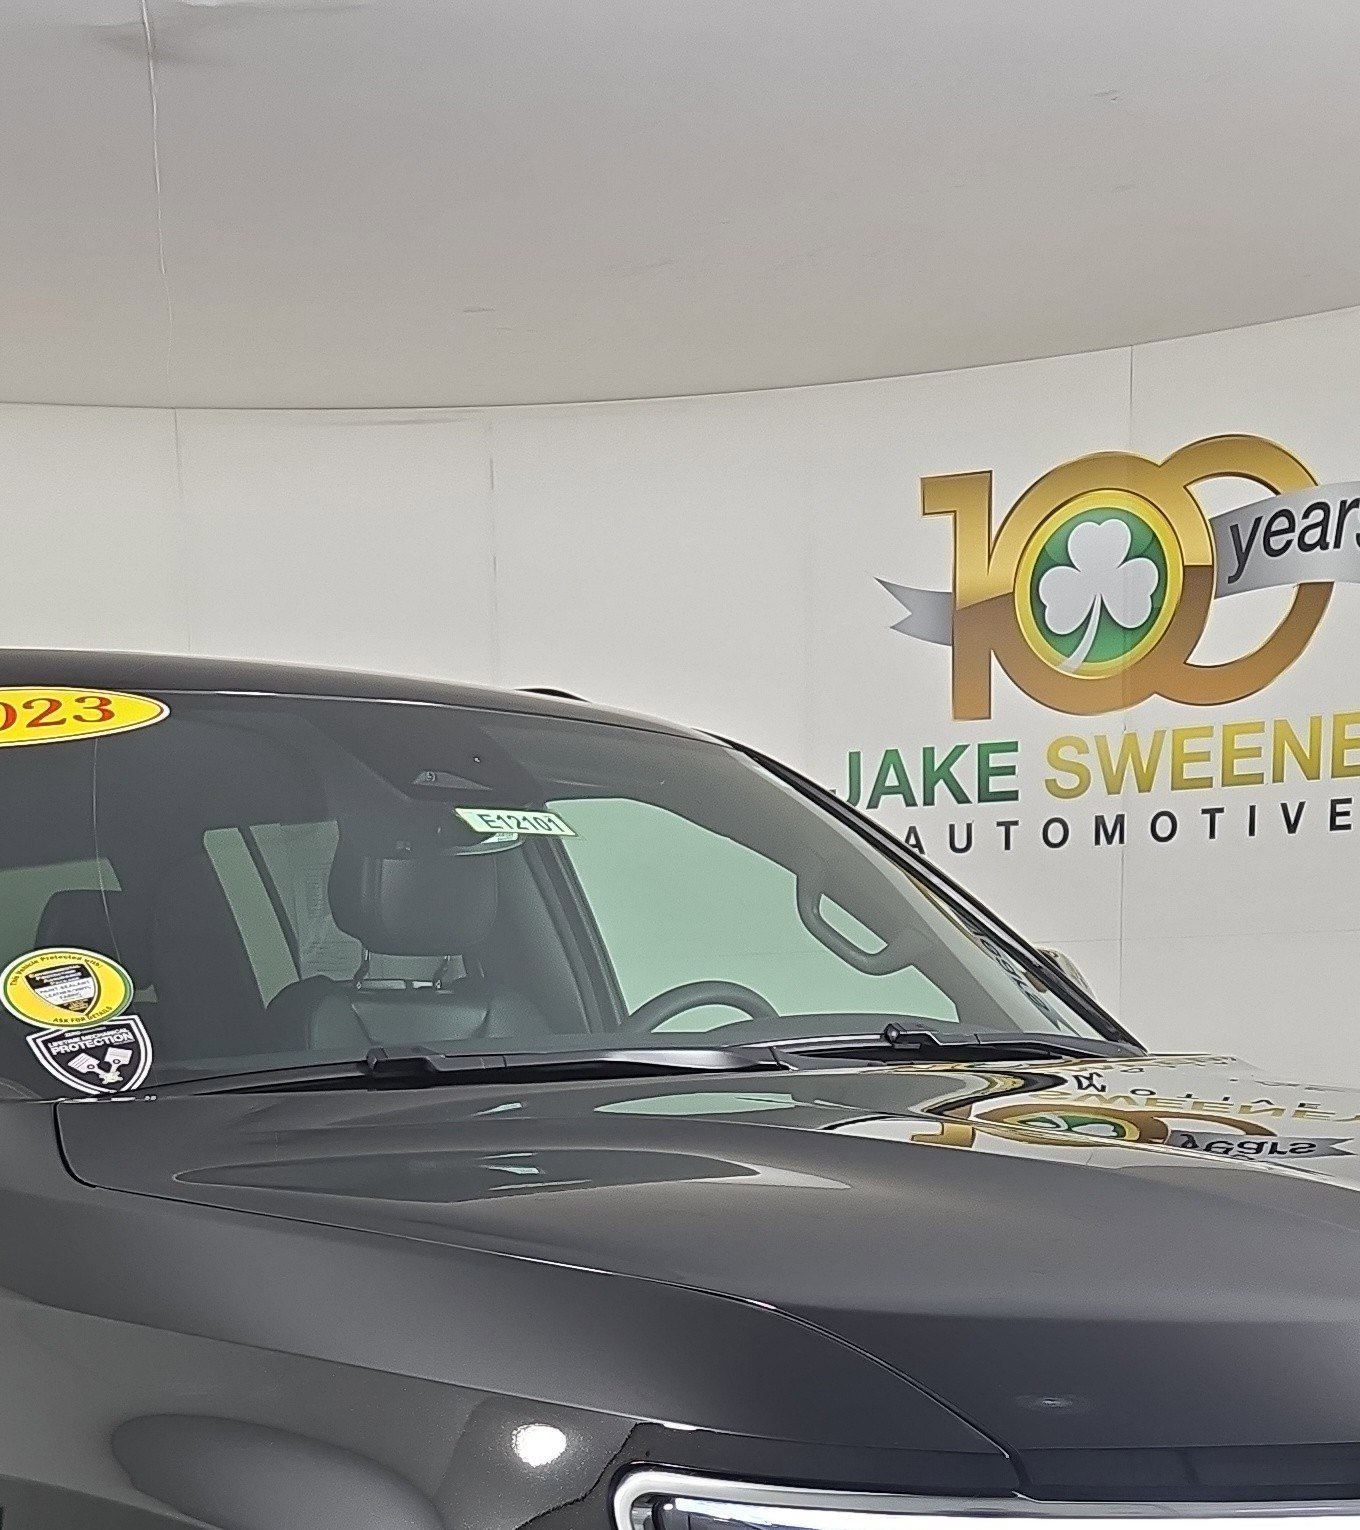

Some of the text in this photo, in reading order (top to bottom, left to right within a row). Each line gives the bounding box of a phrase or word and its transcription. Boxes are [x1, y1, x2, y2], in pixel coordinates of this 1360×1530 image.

[920, 433, 1335, 722] 100
[834, 740, 1019, 812] JAKE
[477, 814, 565, 833] E12101
[904, 797, 1355, 857] AUTOMOTIVE
[50, 1031, 135, 1056] PROTECTION
